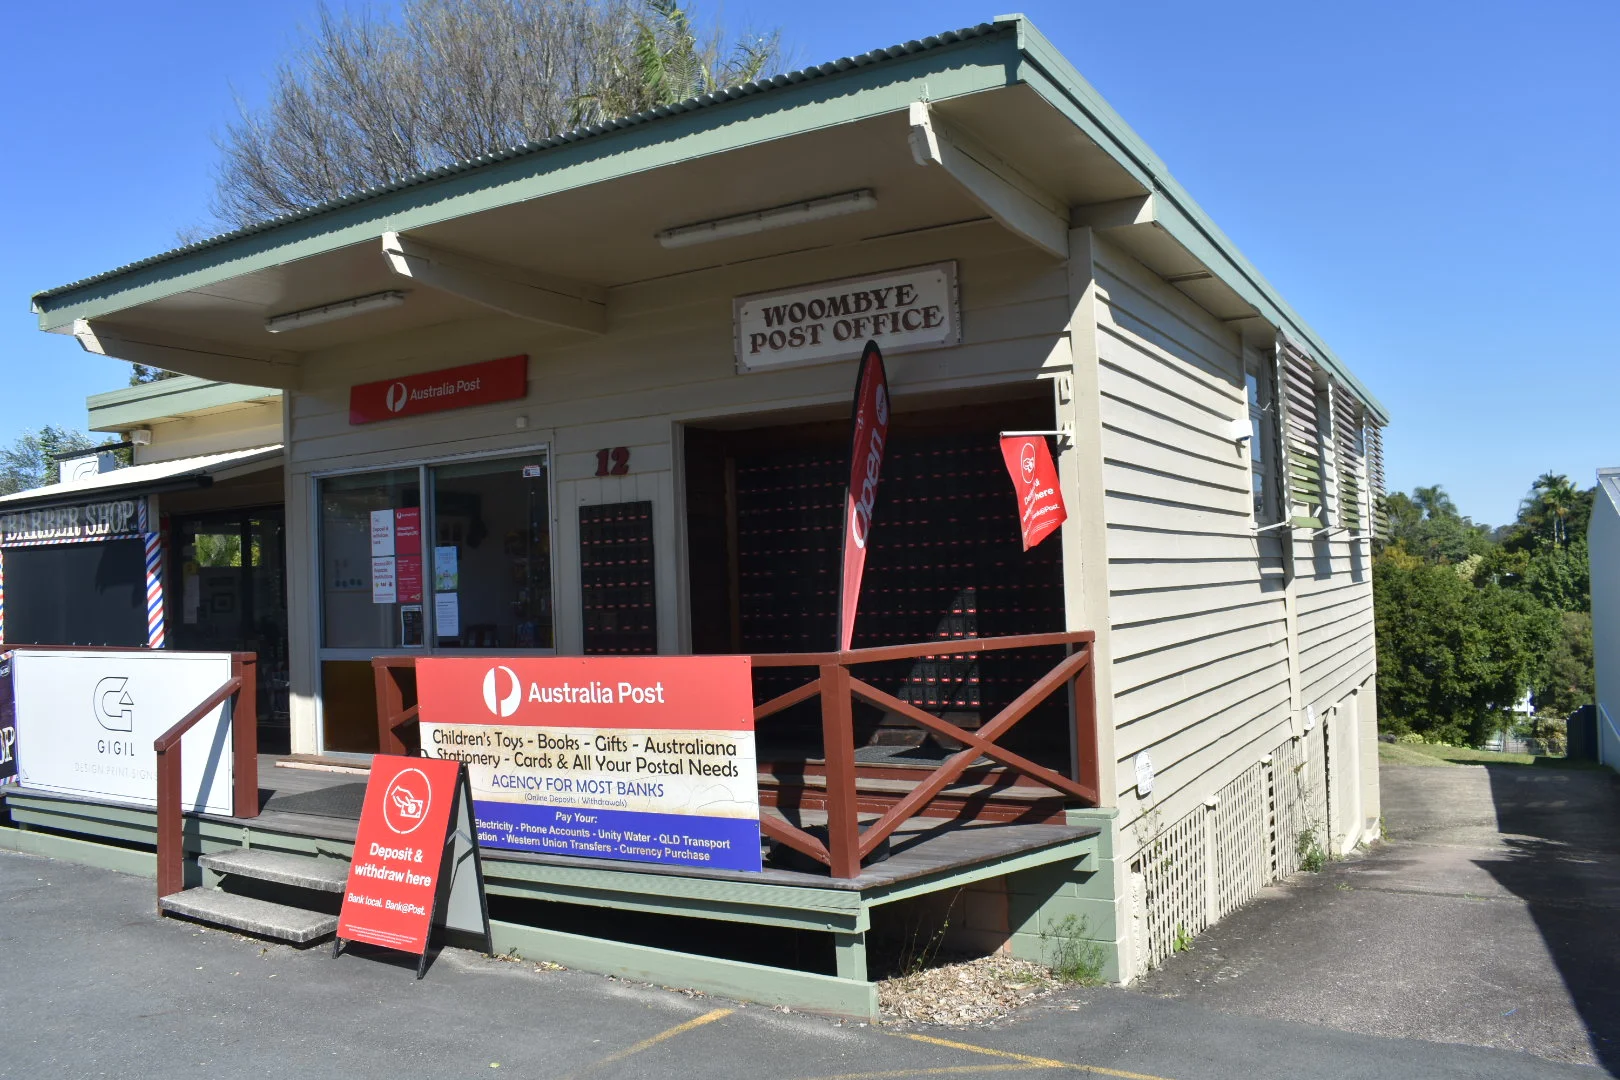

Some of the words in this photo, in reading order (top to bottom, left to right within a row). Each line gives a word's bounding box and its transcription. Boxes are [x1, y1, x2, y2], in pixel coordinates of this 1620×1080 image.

[762, 284, 918, 327] WOOMBYE
[749, 324, 824, 353] POST
[833, 305, 944, 341] OFFICE
[410, 383, 454, 401] Australia
[457, 378, 480, 393] Post
[595, 447, 630, 476] 12
[852, 428, 882, 548] Open
[1035, 488, 1054, 500] here
[6, 507, 80, 541] BARBER
[86, 500, 134, 534] SHOP
[528, 682, 614, 703] Australia
[618, 682, 664, 703] Post
[98, 740, 134, 756] GIGIL
[433, 729, 491, 746] Children's
[495, 732, 524, 750] Toys
[538, 734, 580, 750] Books
[595, 735, 628, 752] Gifts
[644, 736, 737, 756] Australiana
[74, 762, 104, 775] DESIGN
[437, 748, 500, 768] Stationery
[514, 752, 553, 768] Cards
[556, 754, 569, 769] &
[573, 754, 591, 770] All
[596, 755, 631, 772] Your
[636, 757, 683, 775] Postal
[689, 759, 739, 778] Needs
[492, 774, 542, 790] AGENCY
[546, 778, 573, 792] FOR
[576, 779, 612, 794] MOST
[617, 781, 664, 797] BANKS
[525, 793, 548, 802] (Online
[549, 795, 576, 804] Deposits
[581, 797, 628, 808] Withdrawals)
[555, 812, 572, 824] Pay
[574, 813, 598, 824] Your:
[475, 818, 514, 833] Electricity
[520, 823, 547, 834] Phone
[549, 826, 590, 838] Accounts
[598, 829, 621, 842] Unity
[624, 830, 651, 842] Water
[659, 834, 680, 845] QLD
[682, 835, 731, 849] Transport
[370, 842, 413, 861] Deposit
[414, 849, 423, 863] &
[506, 834, 540, 846] Western
[542, 837, 568, 848] Union
[570, 840, 612, 852] Transfers
[620, 844, 662, 858] Currency
[664, 847, 710, 861] Purchase
[355, 863, 405, 882] withdraw
[406, 870, 432, 886] here
[348, 893, 364, 904] Bank
[365, 896, 382, 908] local.
[385, 900, 426, 915] Bank@Post.
